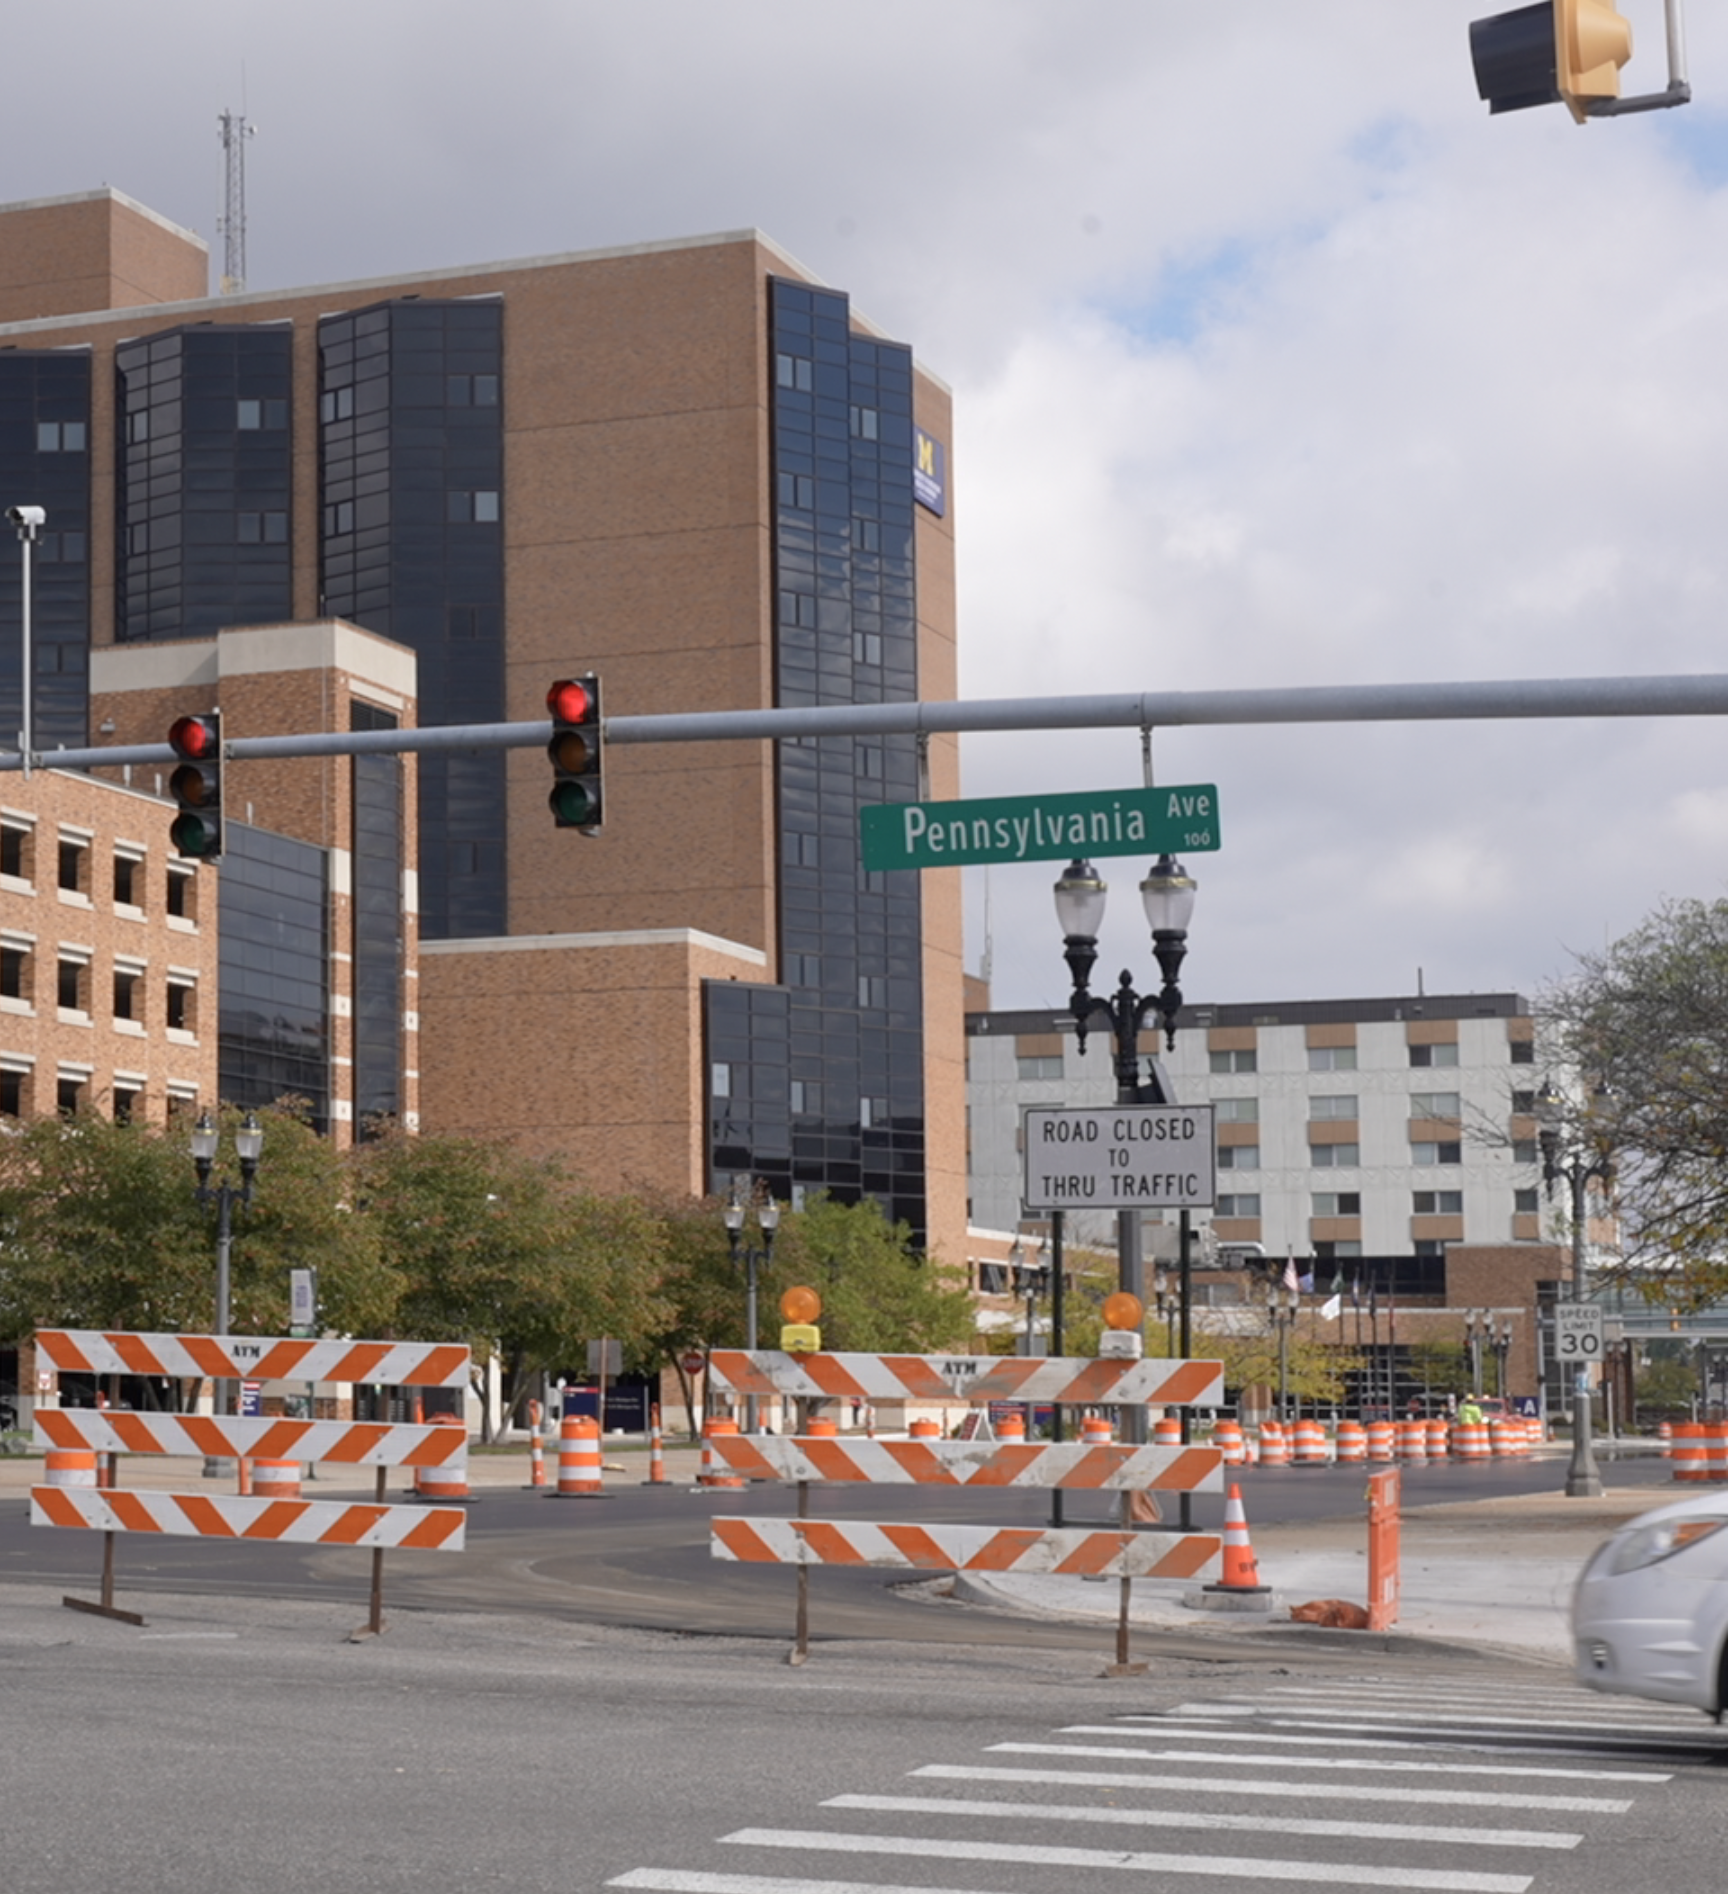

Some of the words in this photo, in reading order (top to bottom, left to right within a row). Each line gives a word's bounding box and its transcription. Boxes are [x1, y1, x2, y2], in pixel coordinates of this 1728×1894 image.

[903, 802, 1146, 858] Pennsylvania
[1167, 793, 1211, 818] Ave
[1184, 829, 1211, 847] 100
[1043, 1120, 1099, 1143] ROAD
[1113, 1118, 1195, 1141] CLOSED
[1108, 1148, 1129, 1168] TO
[1042, 1175, 1096, 1198] THRU
[1111, 1173, 1198, 1197] TRAFFIC
[1559, 1308, 1599, 1320] SPEED
[1563, 1321, 1594, 1331] LIMIT
[231, 1344, 260, 1358] ATM
[1561, 1333, 1599, 1354] 30
[941, 1361, 976, 1375] ATM
[1524, 1399, 1536, 1415] A
